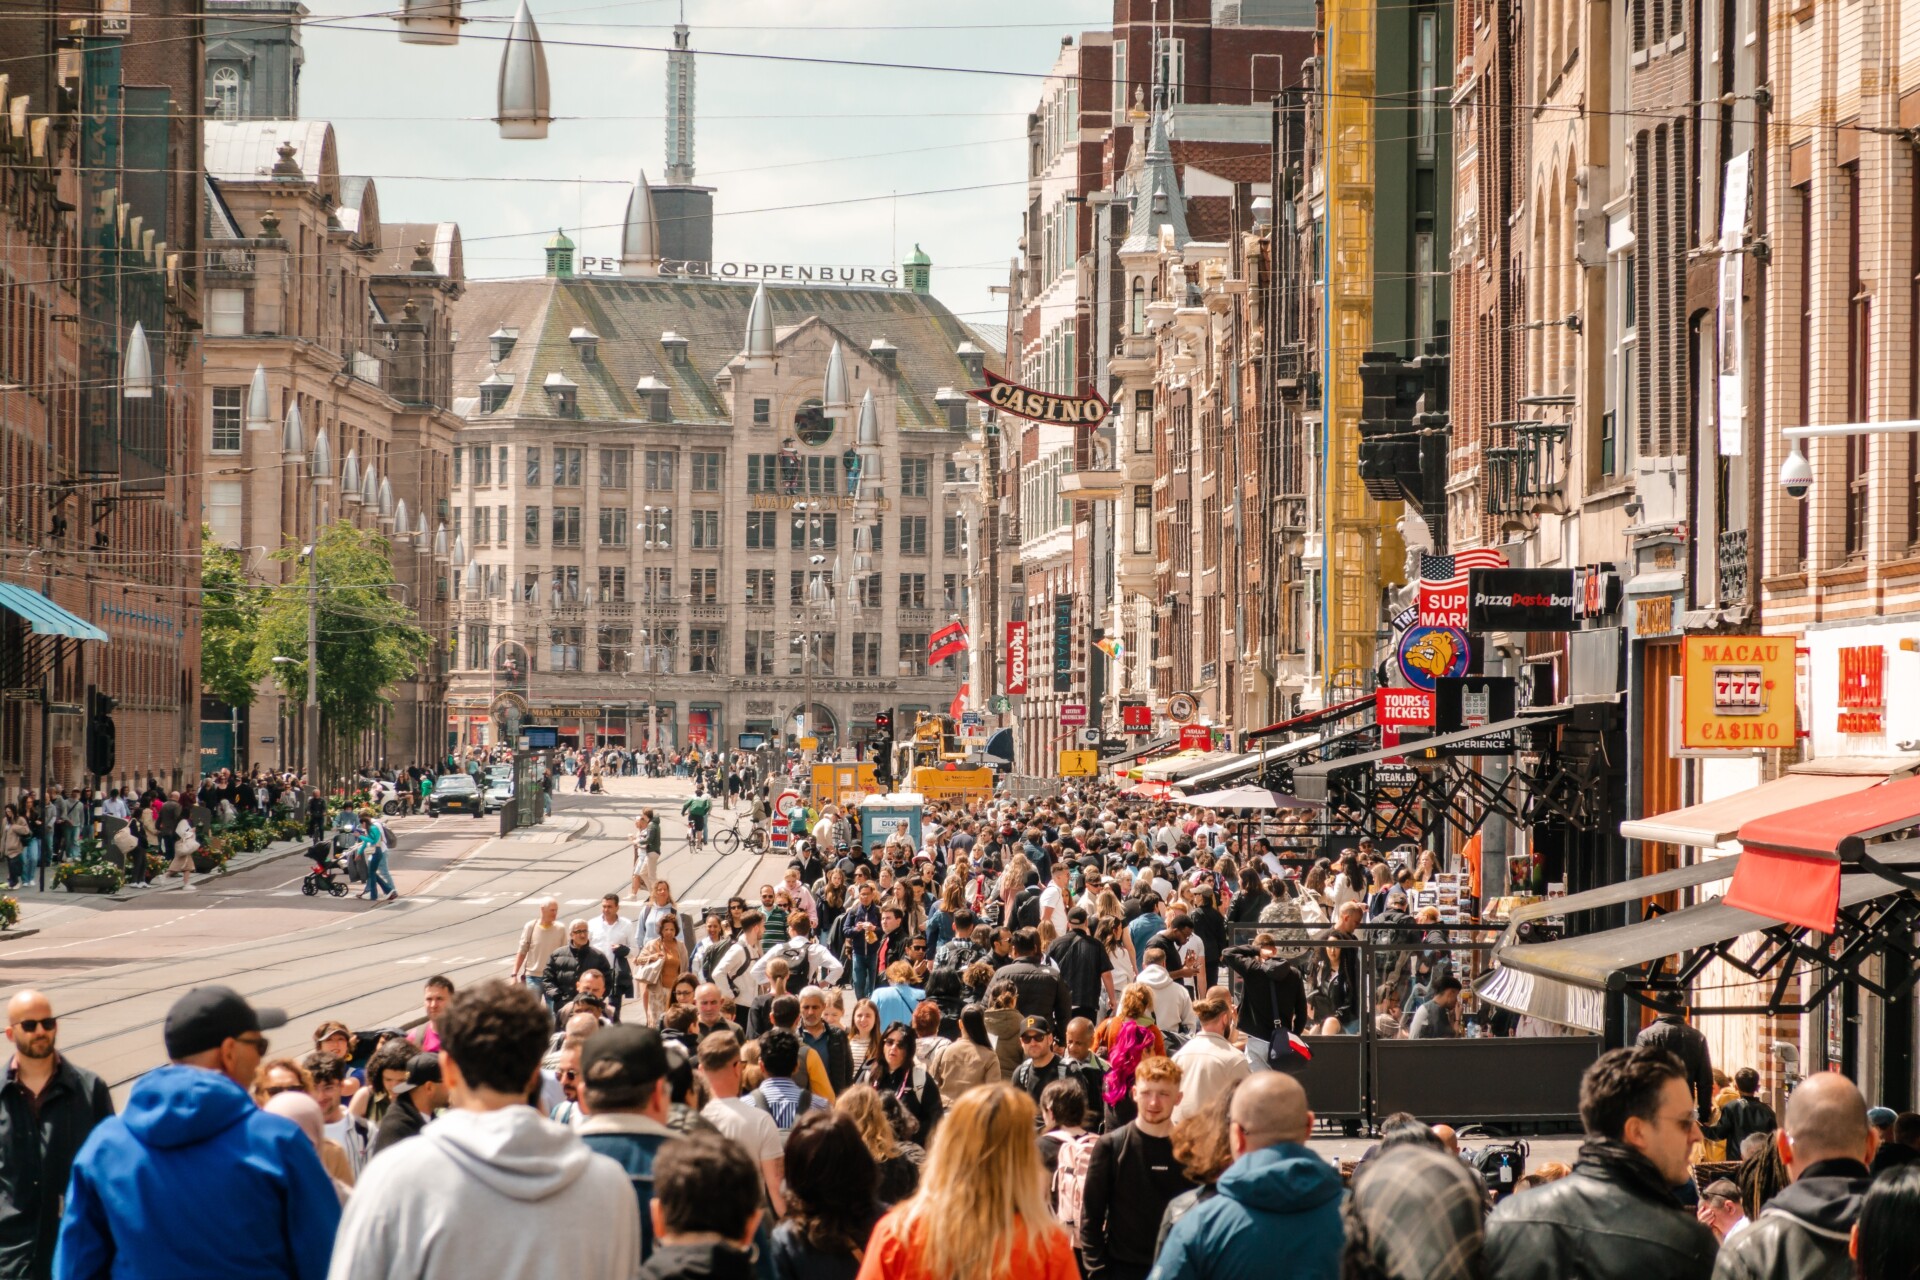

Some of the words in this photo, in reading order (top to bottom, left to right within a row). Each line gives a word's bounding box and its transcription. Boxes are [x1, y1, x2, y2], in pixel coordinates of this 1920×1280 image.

[90, 85, 108, 229] BERLAGE
[683, 260, 898, 283] CLOPPENBURG
[990, 382, 1104, 422] CASINO
[752, 494, 822, 510] MADAM
[1428, 594, 1468, 609] SUP
[1394, 607, 1419, 629] THE
[1057, 604, 1069, 684] PRIMARK
[1702, 645, 1779, 662] MACAU
[532, 708, 566, 718] MADAME
[569, 708, 601, 718] TUSSAUD
[1385, 707, 1430, 719] TICKETS
[1375, 773, 1401, 782] STEAK
[1406, 773, 1417, 782] BU
[1027, 1018, 1035, 1028] P
